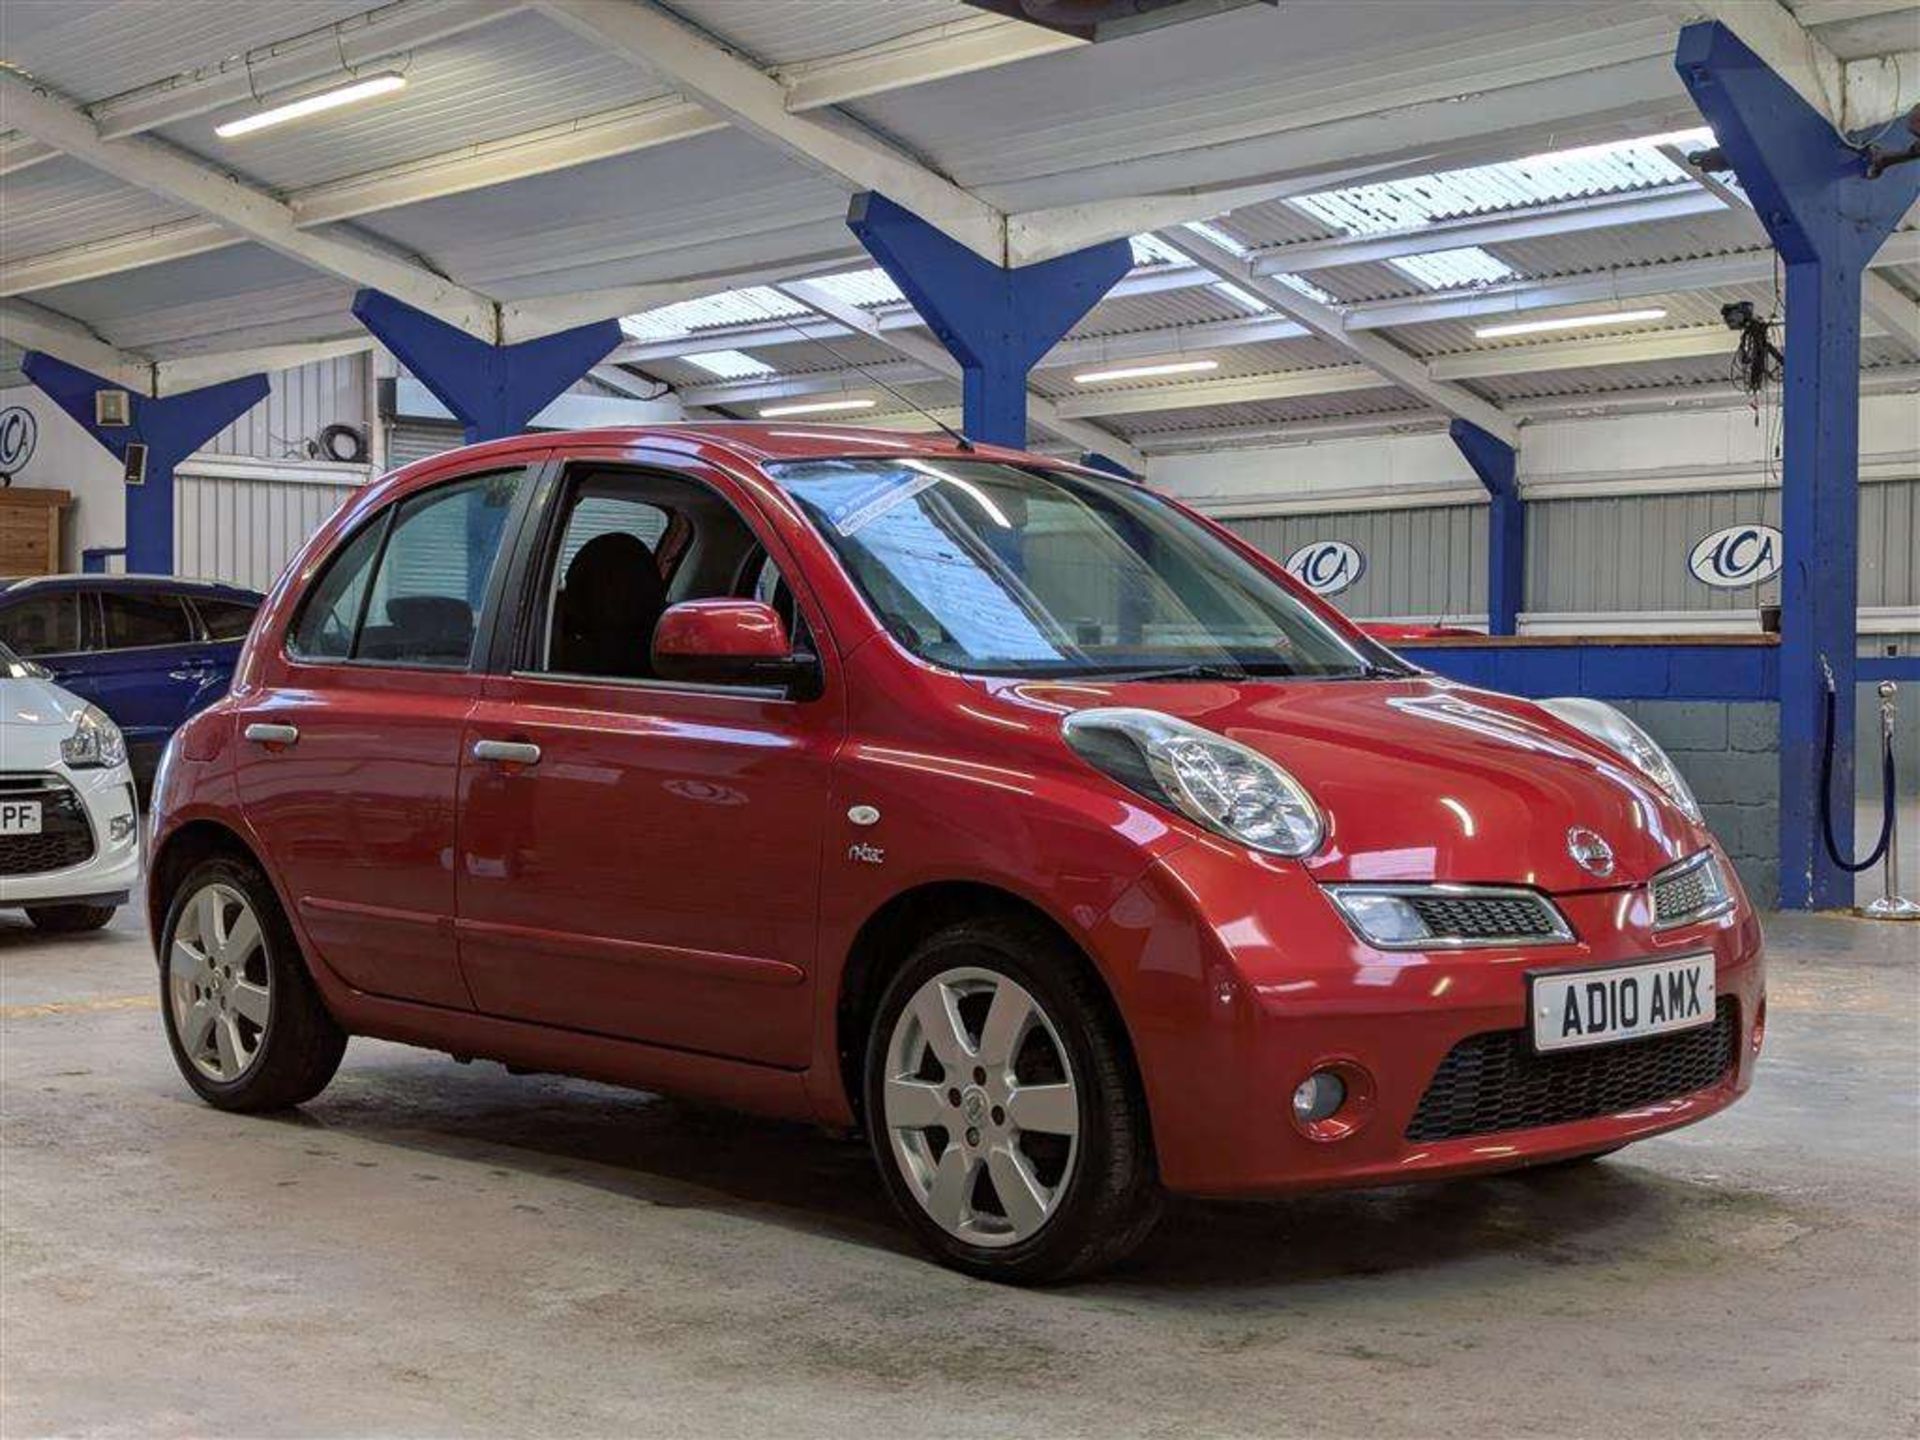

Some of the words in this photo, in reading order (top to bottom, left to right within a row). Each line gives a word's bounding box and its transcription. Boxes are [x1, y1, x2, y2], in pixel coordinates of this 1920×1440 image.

[1293, 546, 1349, 587] ACA
[1695, 531, 1774, 578] ACA
[2, 806, 33, 829] PF
[1562, 978, 1639, 1037] AD10
[1651, 967, 1701, 1024] AMX
